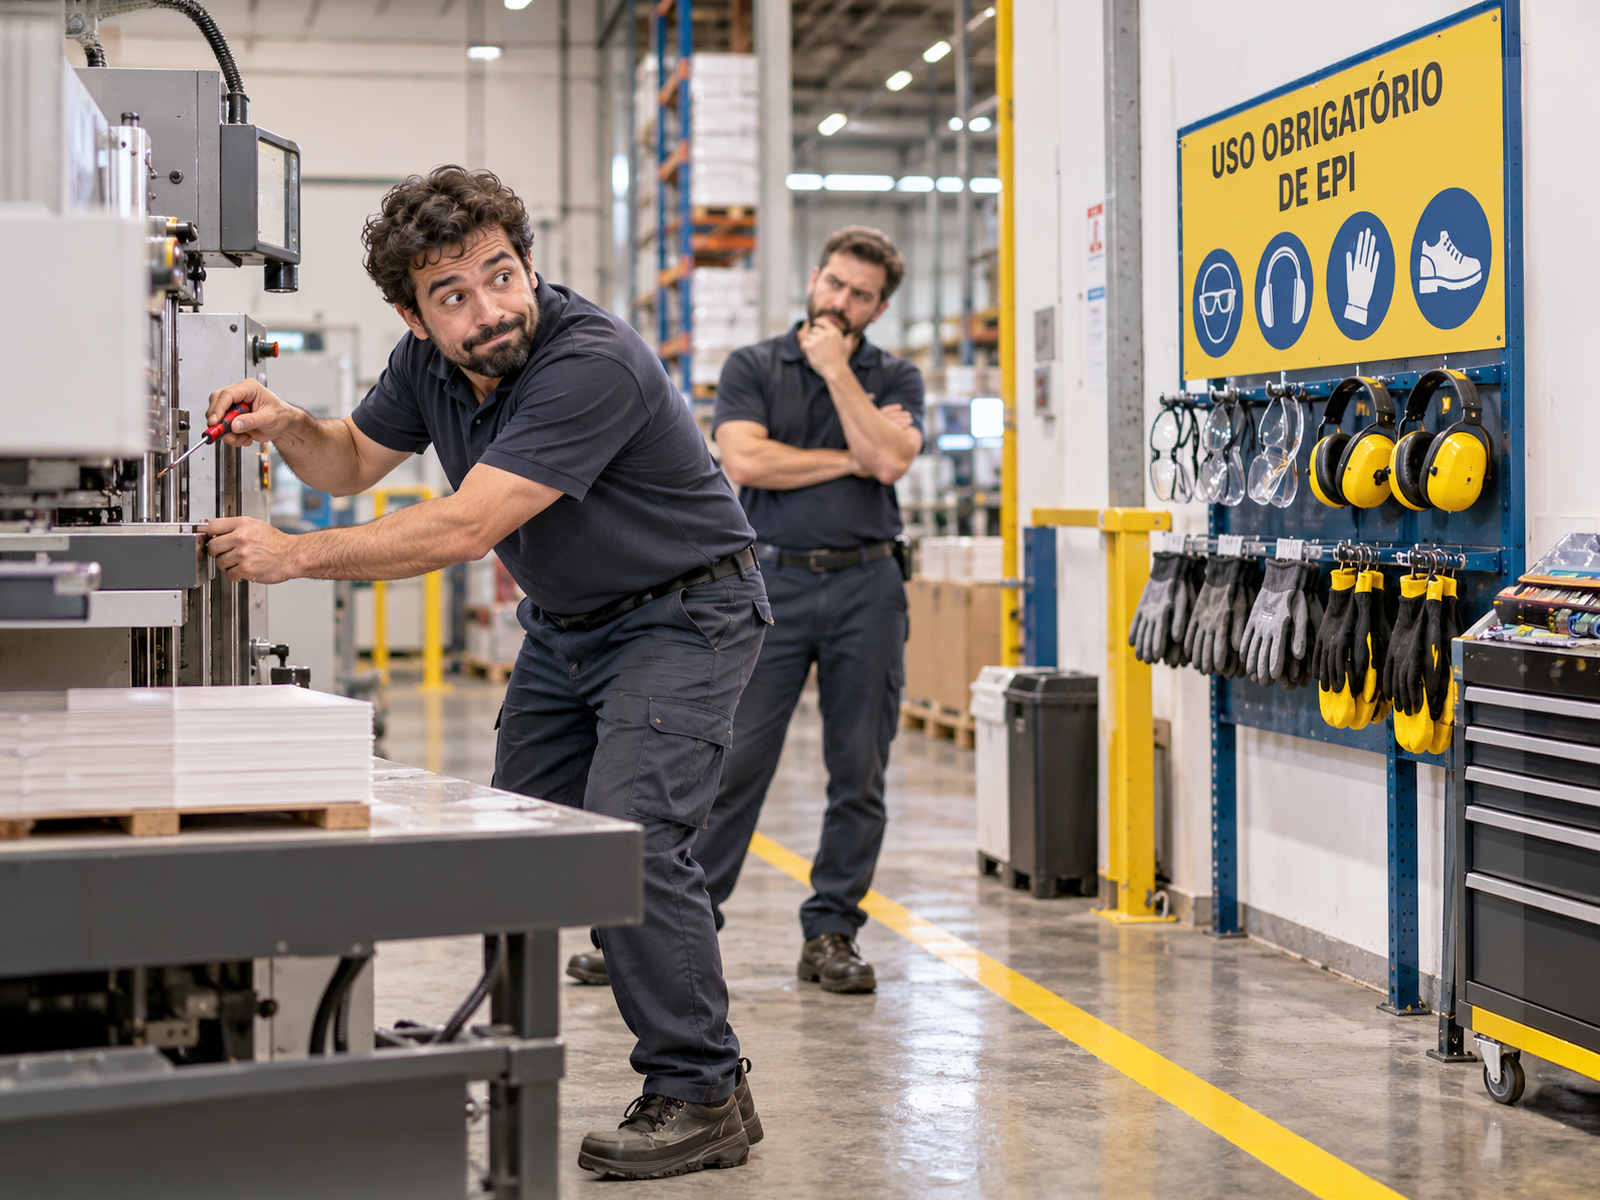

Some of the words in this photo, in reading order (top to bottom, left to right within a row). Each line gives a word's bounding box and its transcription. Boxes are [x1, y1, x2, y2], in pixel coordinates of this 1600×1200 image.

[1212, 131, 1255, 179] USO
[1262, 61, 1443, 162] OBRIGATÓRIO
[1279, 166, 1308, 213] DE
[1316, 150, 1355, 202] EPI
